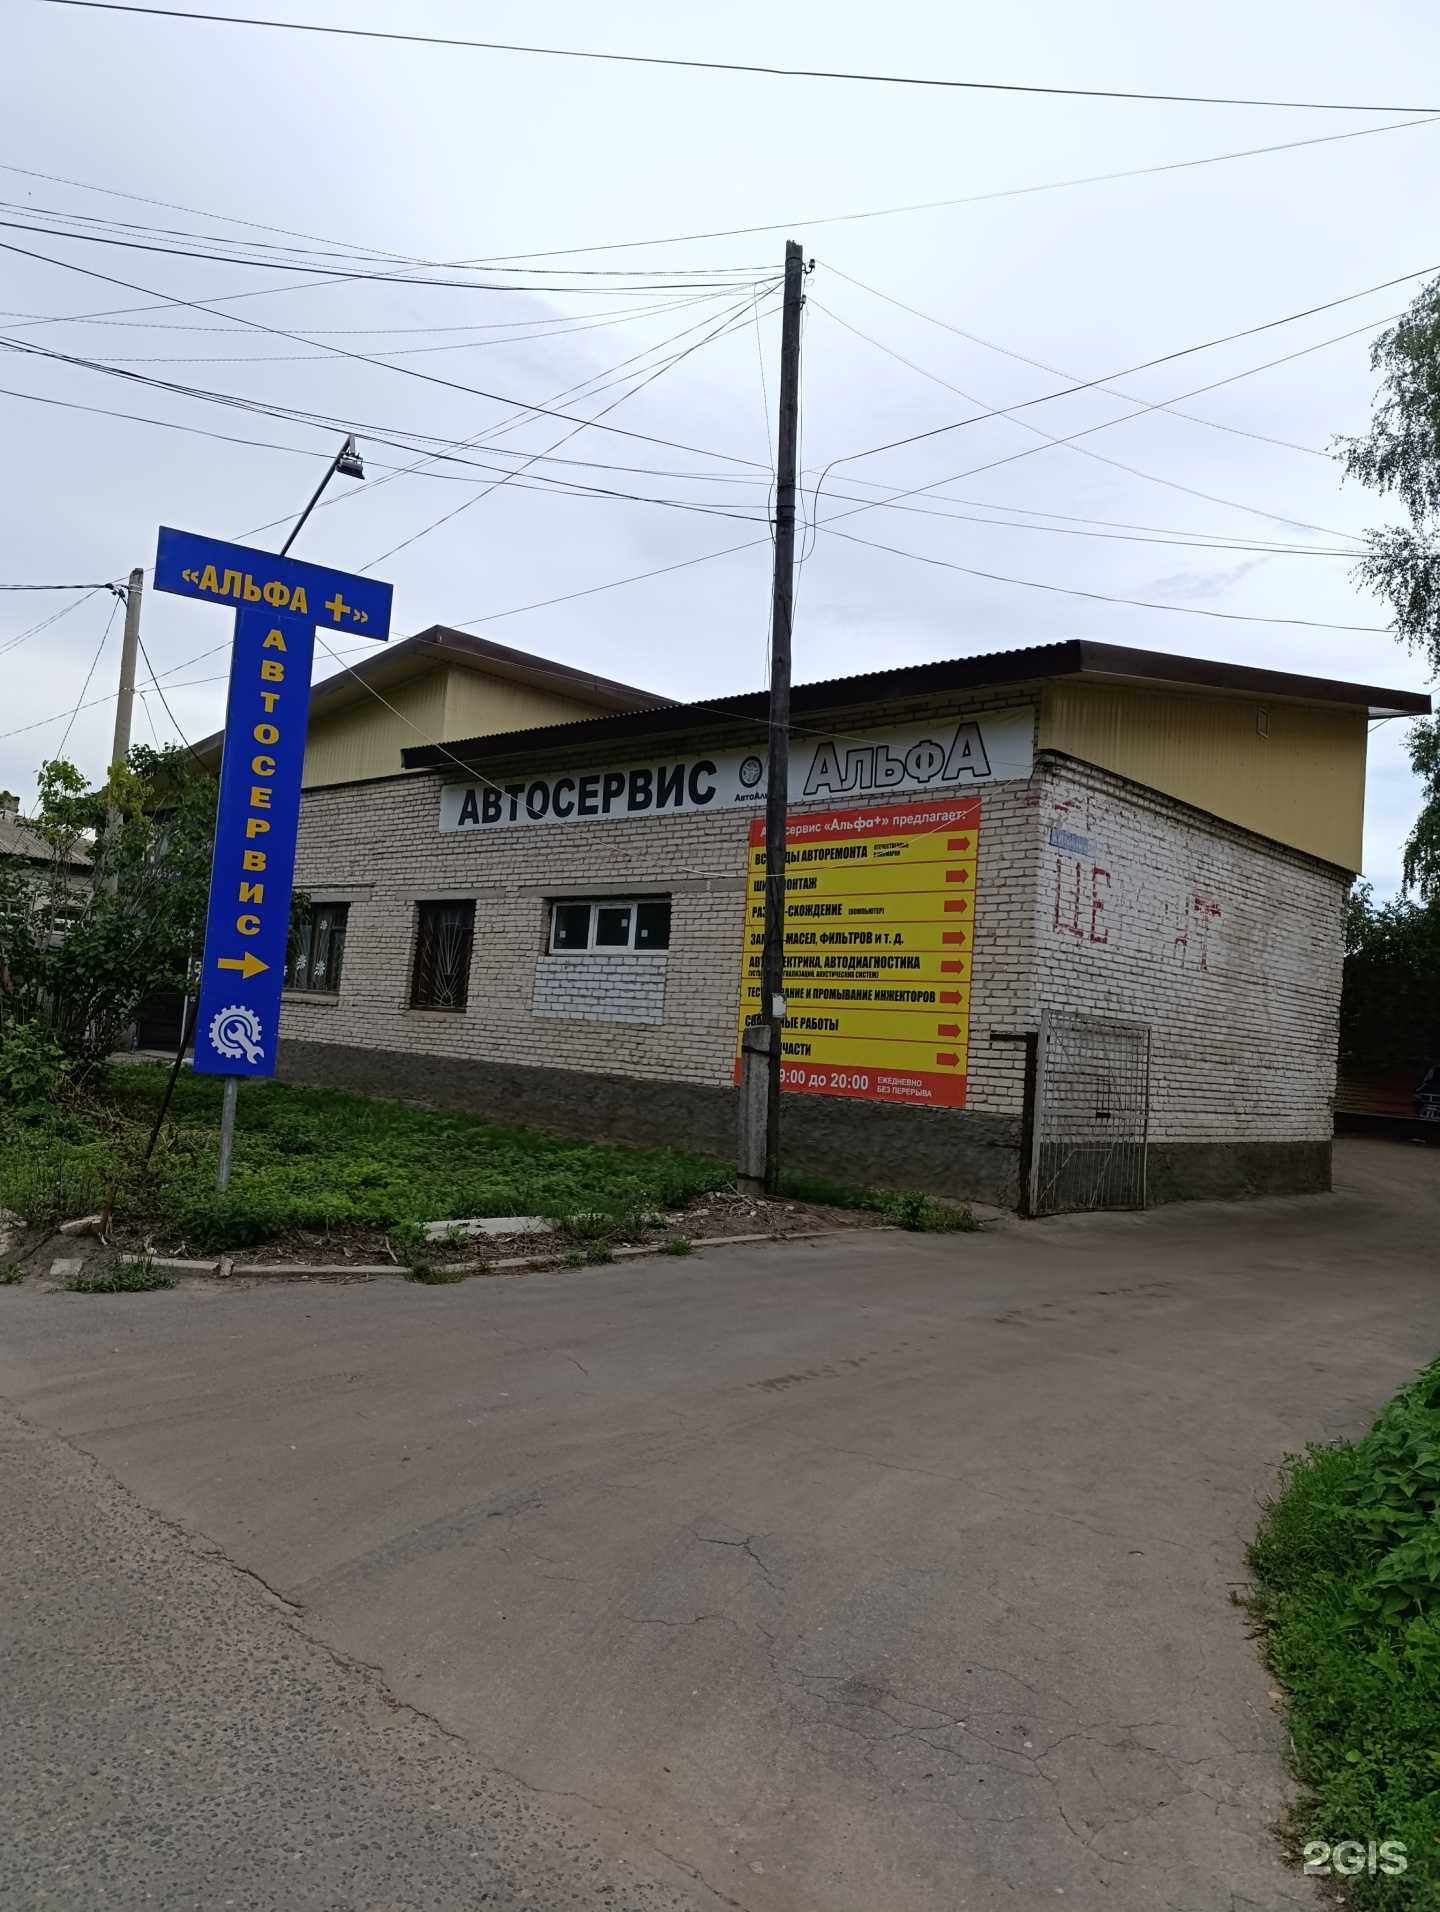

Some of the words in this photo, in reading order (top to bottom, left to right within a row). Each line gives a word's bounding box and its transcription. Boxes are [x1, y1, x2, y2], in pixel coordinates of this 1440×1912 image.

[182, 564, 308, 614] «АЛЬФА
[236, 628, 287, 935] АВТОСЕРВИС
[458, 760, 717, 826] АВТОСЕРВИС
[760, 823, 821, 838] Асервис
[893, 810, 967, 827] предлагает:
[801, 845, 868, 862] АВТОРЕМОНТА
[819, 931, 873, 945] ФИЛЬТРОВ
[823, 955, 921, 971] АВТОДИАГНОСТИКА
[812, 988, 872, 1001] ПРОМЫВАНИЕ
[873, 990, 936, 1003] ИНЖЕКТОРОВ
[800, 1018, 839, 1031] РАБОТЫ
[808, 1073, 827, 1087] до
[830, 1072, 869, 1090] 20:00
[877, 1076, 922, 1087] ЕЖЕДНЕВНО
